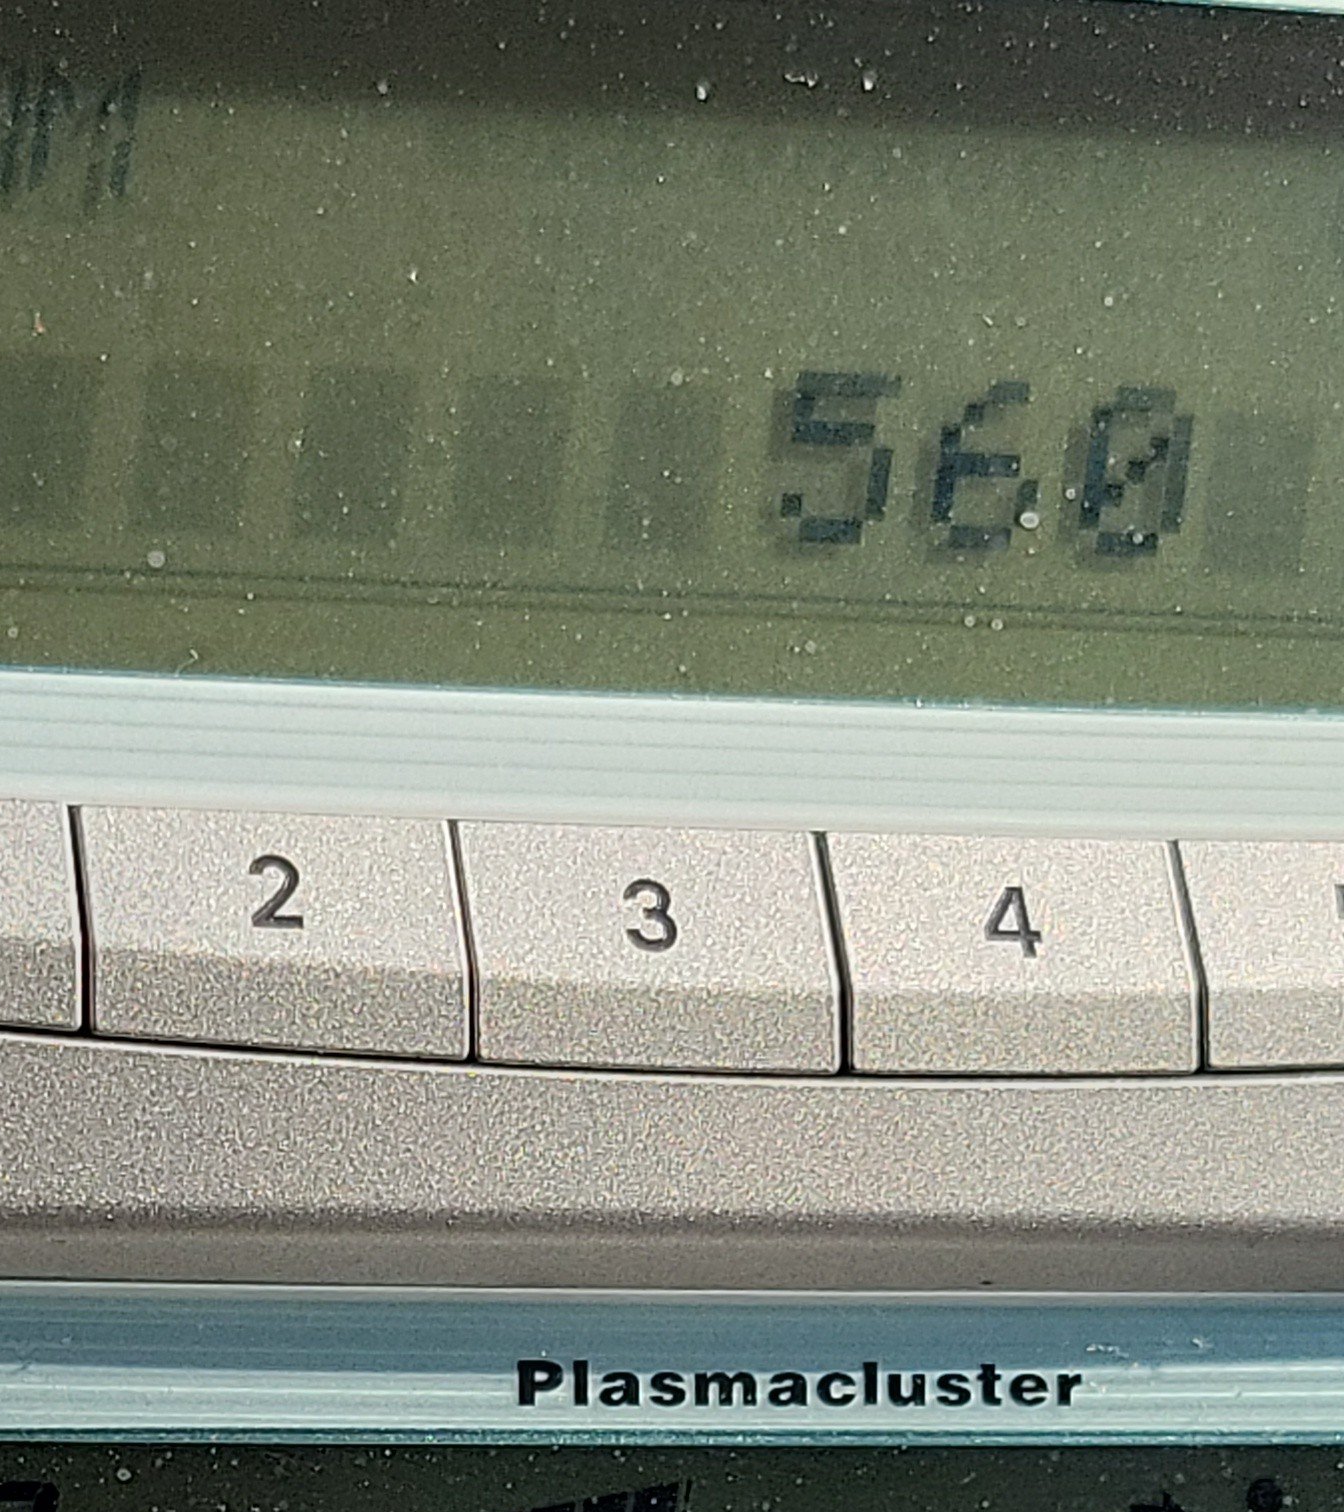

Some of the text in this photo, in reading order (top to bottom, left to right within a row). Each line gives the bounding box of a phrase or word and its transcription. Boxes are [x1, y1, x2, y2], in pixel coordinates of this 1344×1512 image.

[776, 369, 1197, 558] 560
[247, 855, 306, 929] 2
[620, 878, 679, 952] 3
[983, 886, 1042, 958] 4
[516, 1357, 1084, 1408] Plasmacluster
